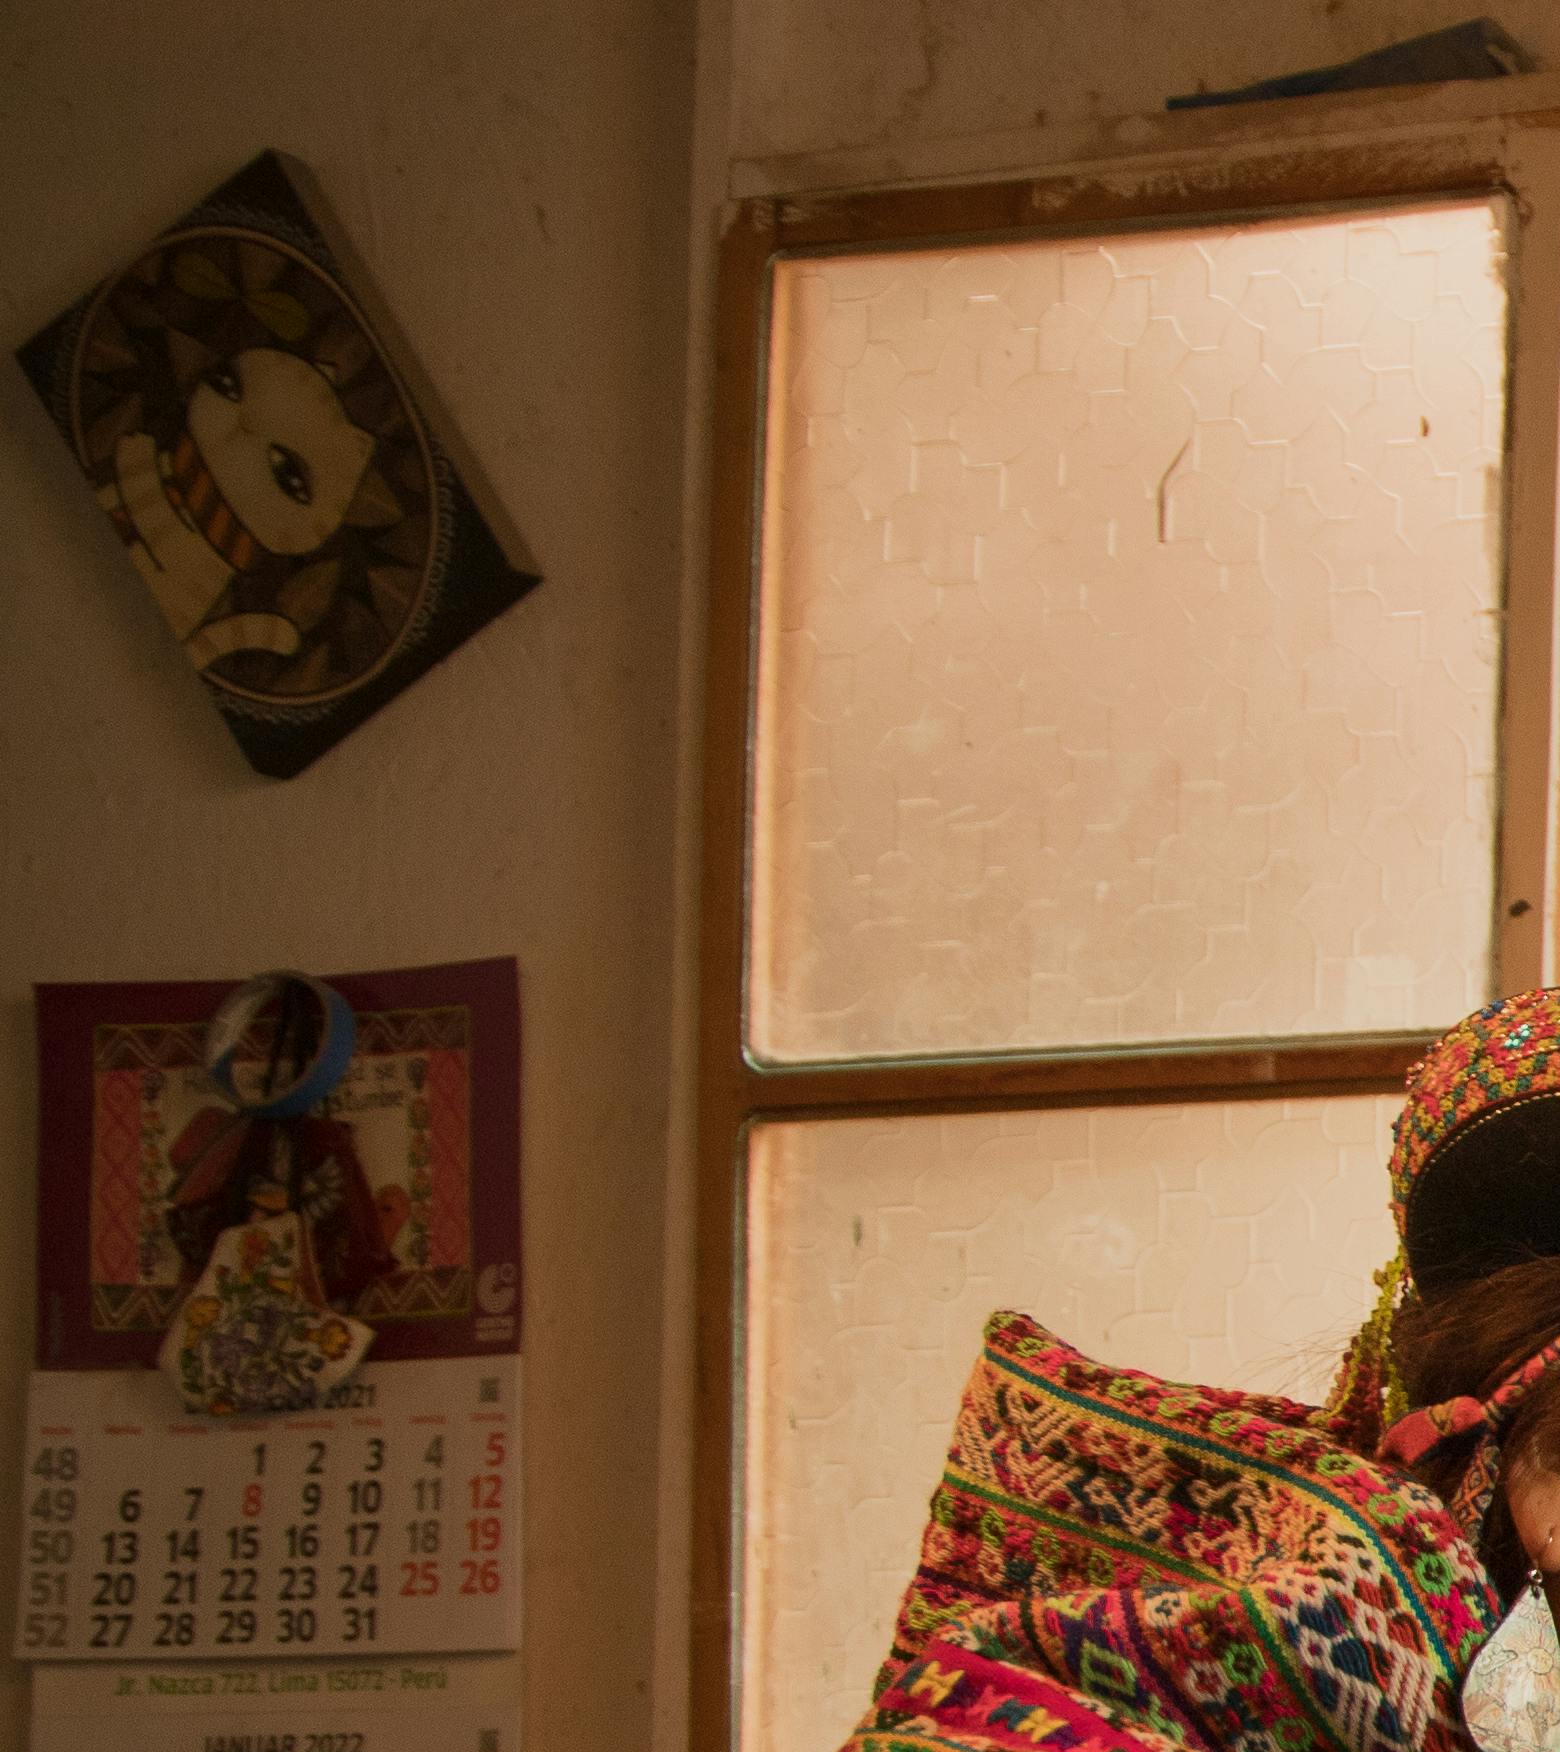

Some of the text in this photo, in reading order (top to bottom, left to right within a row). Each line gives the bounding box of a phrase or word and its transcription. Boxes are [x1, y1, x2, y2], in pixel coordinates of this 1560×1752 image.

[32, 1432, 505, 1482] 48 1 2 3 4 5
[30, 1475, 503, 1523] 49 6 7 8 9 10 11 12
[30, 1517, 501, 1565] 50 13 14 15 16 17 18 19
[30, 1559, 500, 1606] 51 20 21 22 23 24 25 26
[25, 1607, 377, 1648] 52 27 28 29 30 31
[115, 1675, 145, 1697] Jr.
[149, 1673, 213, 1696] Nazca
[269, 1671, 318, 1691] Lima
[327, 1670, 383, 1691] 15072
[401, 1669, 447, 1690] Perú
